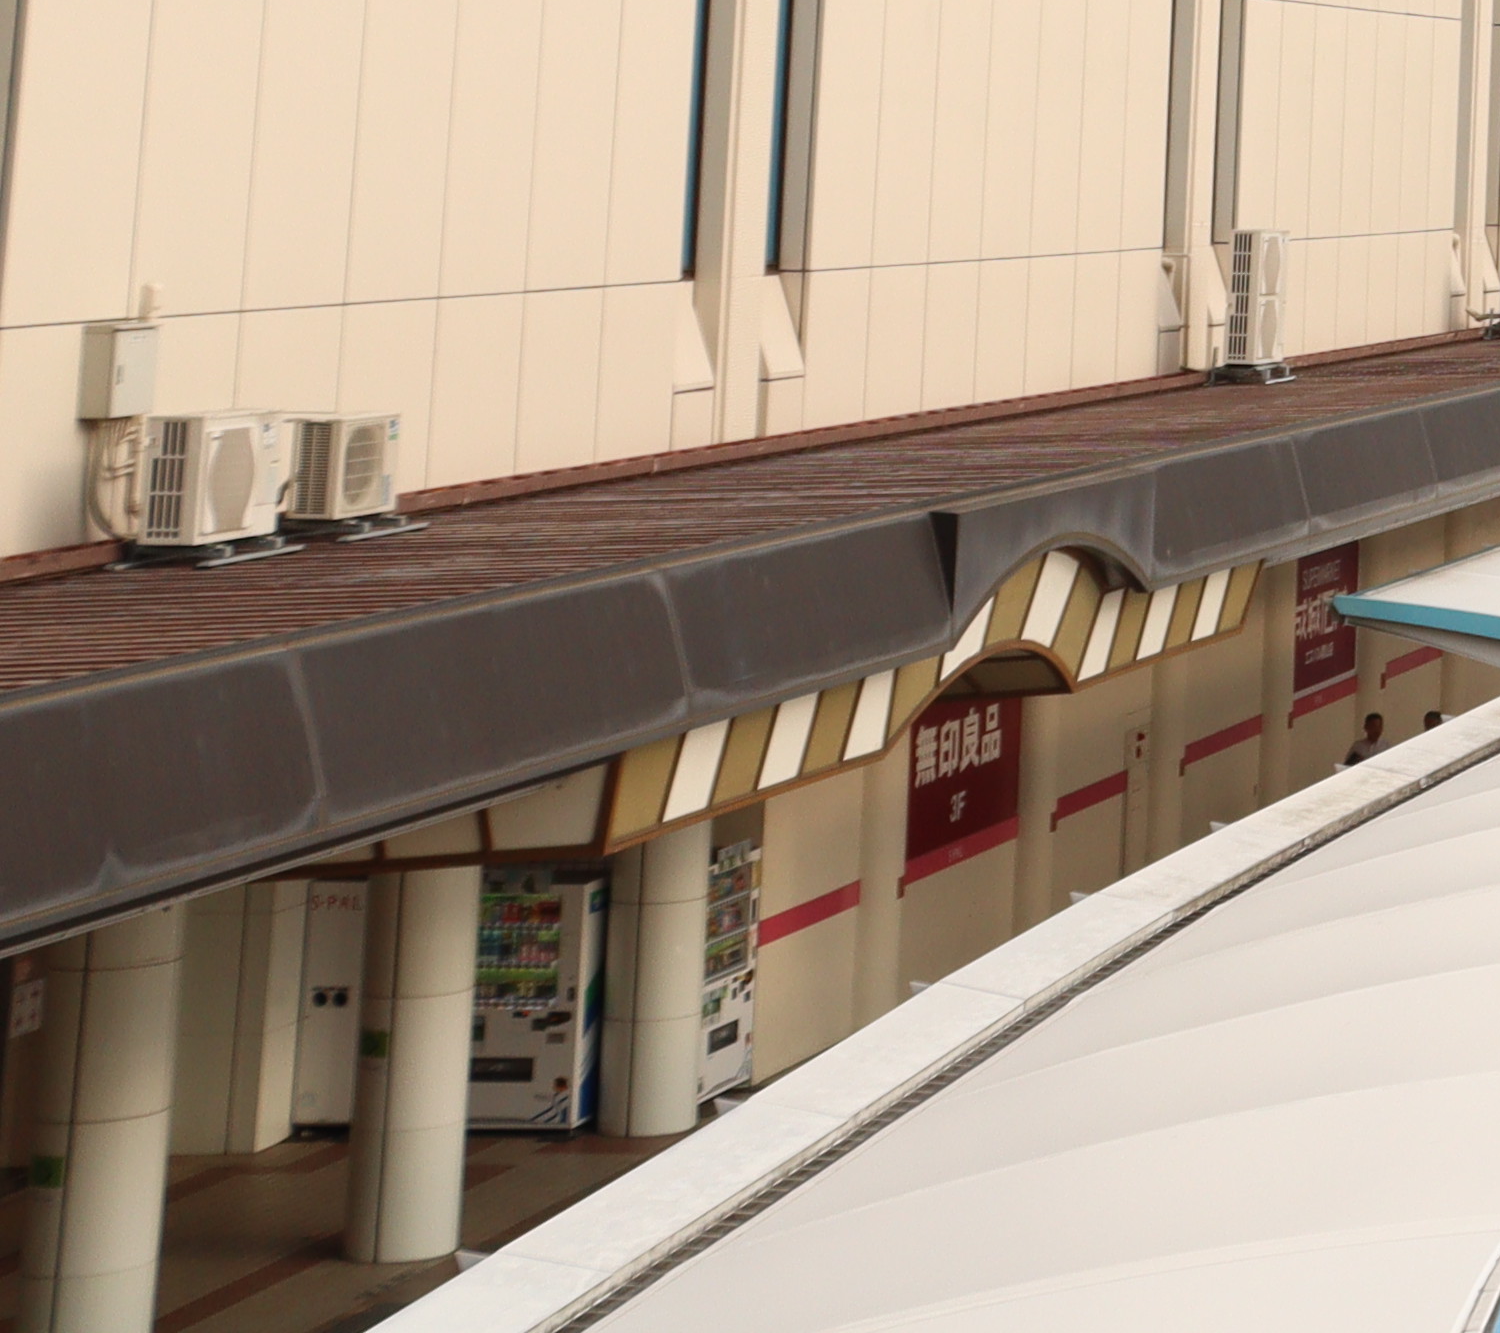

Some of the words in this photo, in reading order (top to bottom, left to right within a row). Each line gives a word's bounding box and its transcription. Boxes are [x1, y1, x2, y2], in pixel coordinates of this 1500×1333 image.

[914, 703, 1002, 789] 無印良品
[949, 791, 967, 822] 3F
[311, 895, 362, 911] S-PAL
